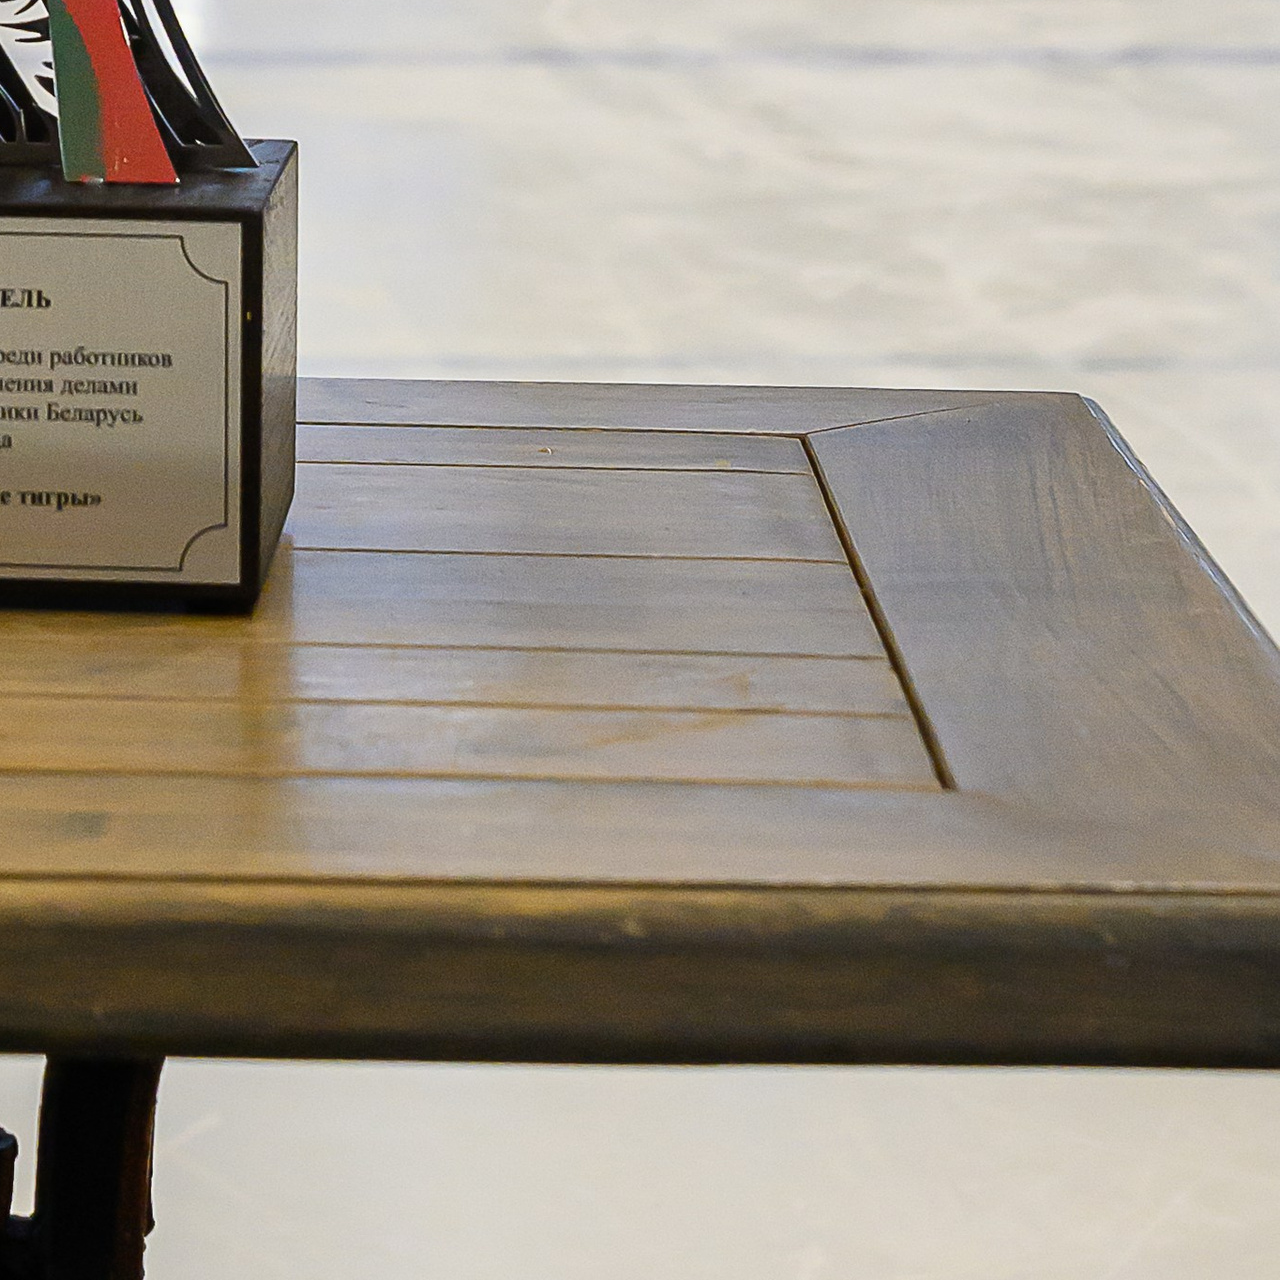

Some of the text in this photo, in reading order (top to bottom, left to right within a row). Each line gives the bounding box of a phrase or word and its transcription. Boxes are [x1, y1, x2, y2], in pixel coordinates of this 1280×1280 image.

[49, 345, 173, 371] работников
[59, 377, 139, 397] делами
[46, 402, 144, 428] Беларусь
[19, 491, 102, 512] тигры»
